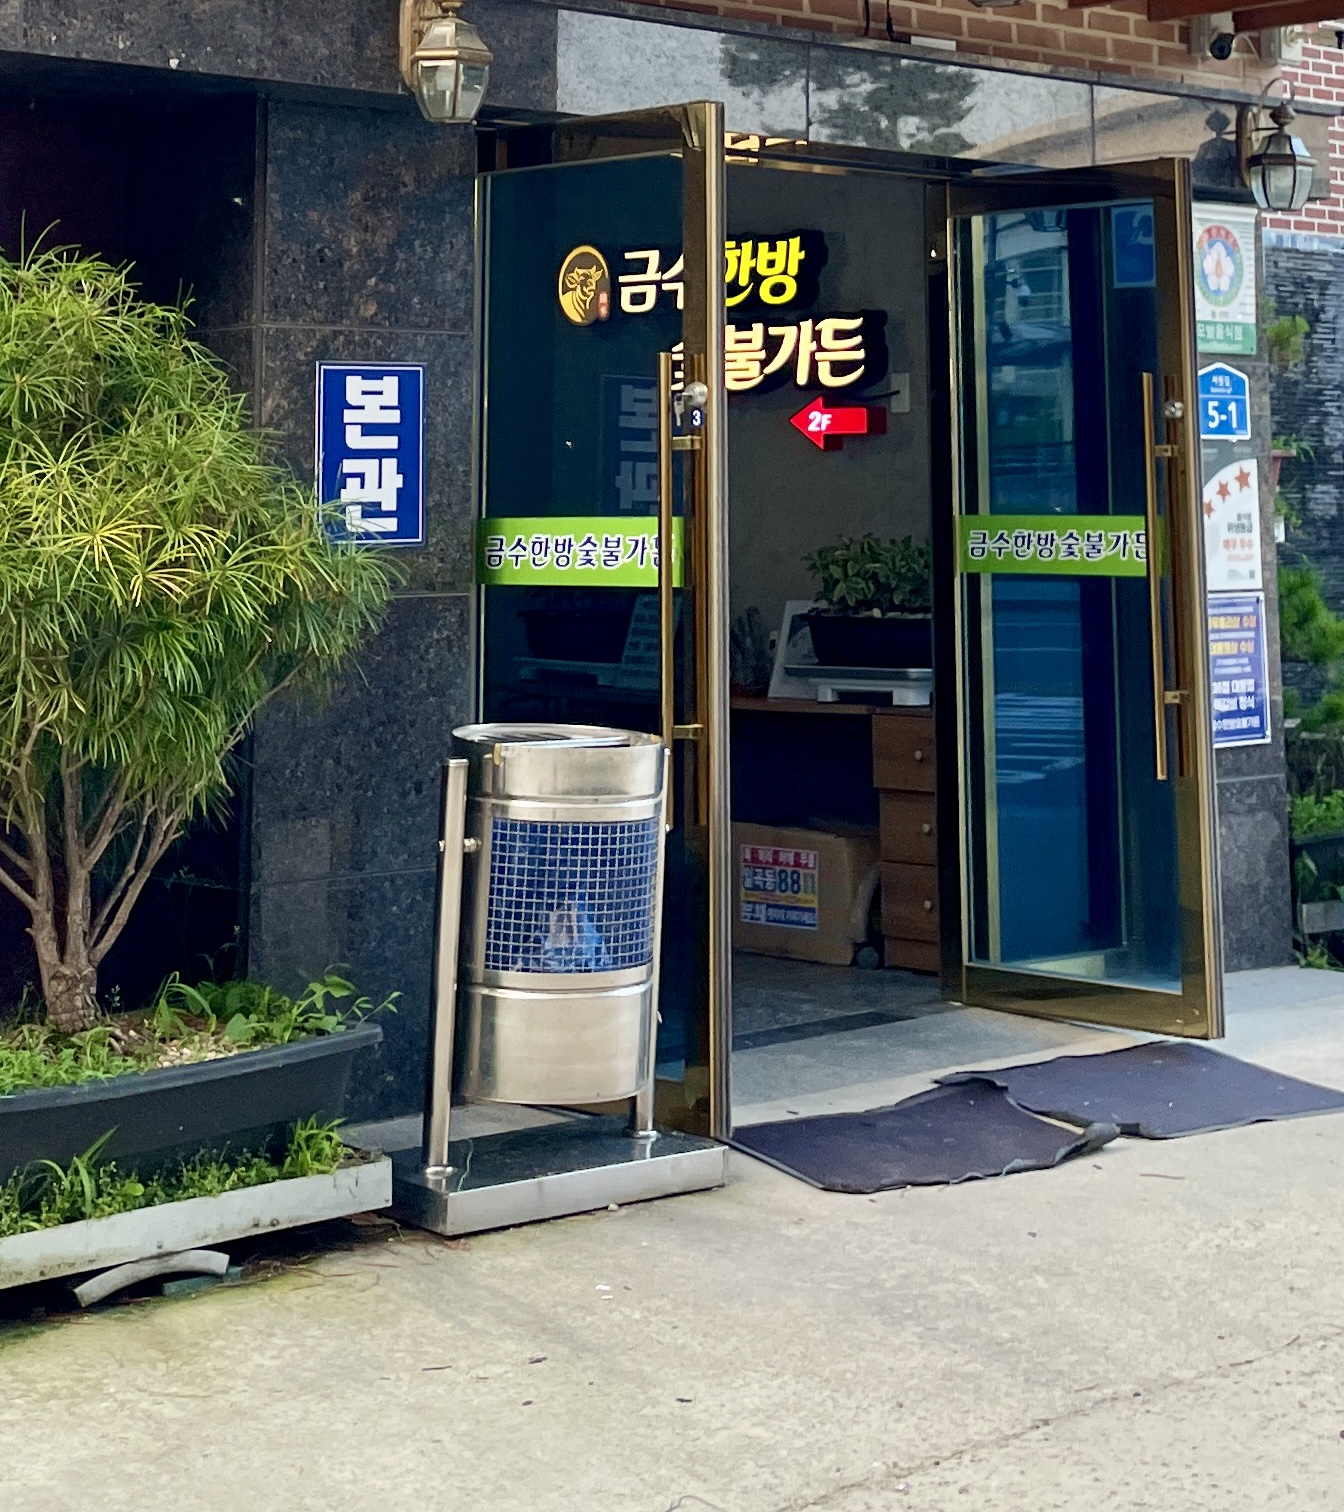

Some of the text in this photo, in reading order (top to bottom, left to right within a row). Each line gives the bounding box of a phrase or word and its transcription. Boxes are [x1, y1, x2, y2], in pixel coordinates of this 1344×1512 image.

[808, 411, 832, 432] 2F
[1208, 400, 1238, 429] 5-1
[341, 376, 403, 532] 본관
